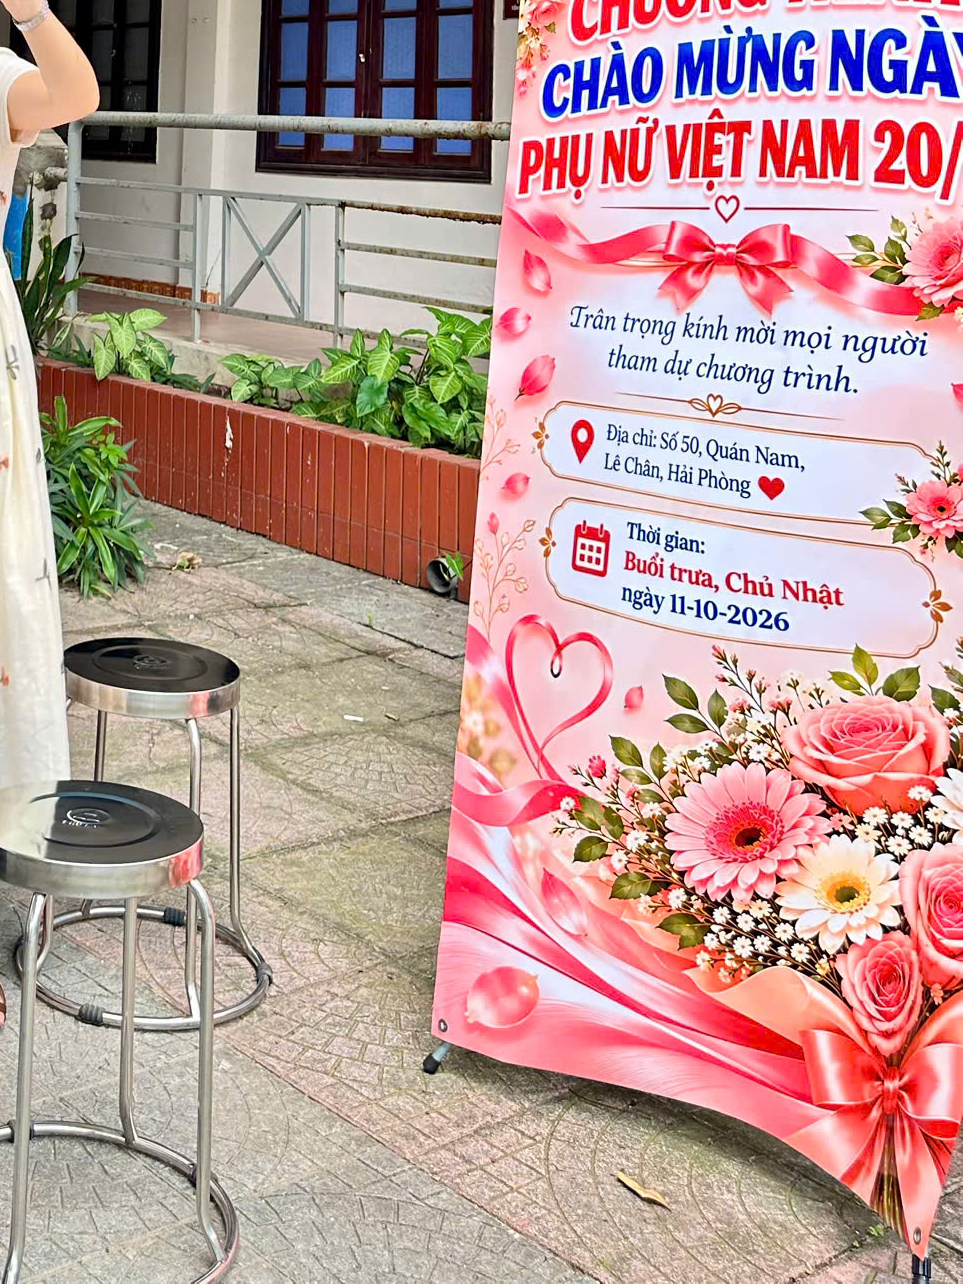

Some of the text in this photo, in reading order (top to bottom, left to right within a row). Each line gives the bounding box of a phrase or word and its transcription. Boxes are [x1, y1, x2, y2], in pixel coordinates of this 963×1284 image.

[542, 15, 963, 118] CHÀO MỪNG NGÀ
[518, 132, 593, 200] PHỤ
[601, 116, 658, 185] NỮ
[666, 108, 752, 191] VIỆT
[758, 119, 860, 182] NAM
[570, 305, 929, 364] Trân trọng kính mời mọi người
[607, 344, 859, 395] tham dự chương trình.
[606, 423, 806, 472] Địa chỉ: Số 50, Quán Nam,
[603, 452, 751, 499] Lê Chân, Hải Phòng
[627, 521, 706, 555] Thời gian:
[623, 549, 845, 609] Buổi trưa, Chủ Nhật
[621, 586, 790, 632] ngày 11-10-2026
